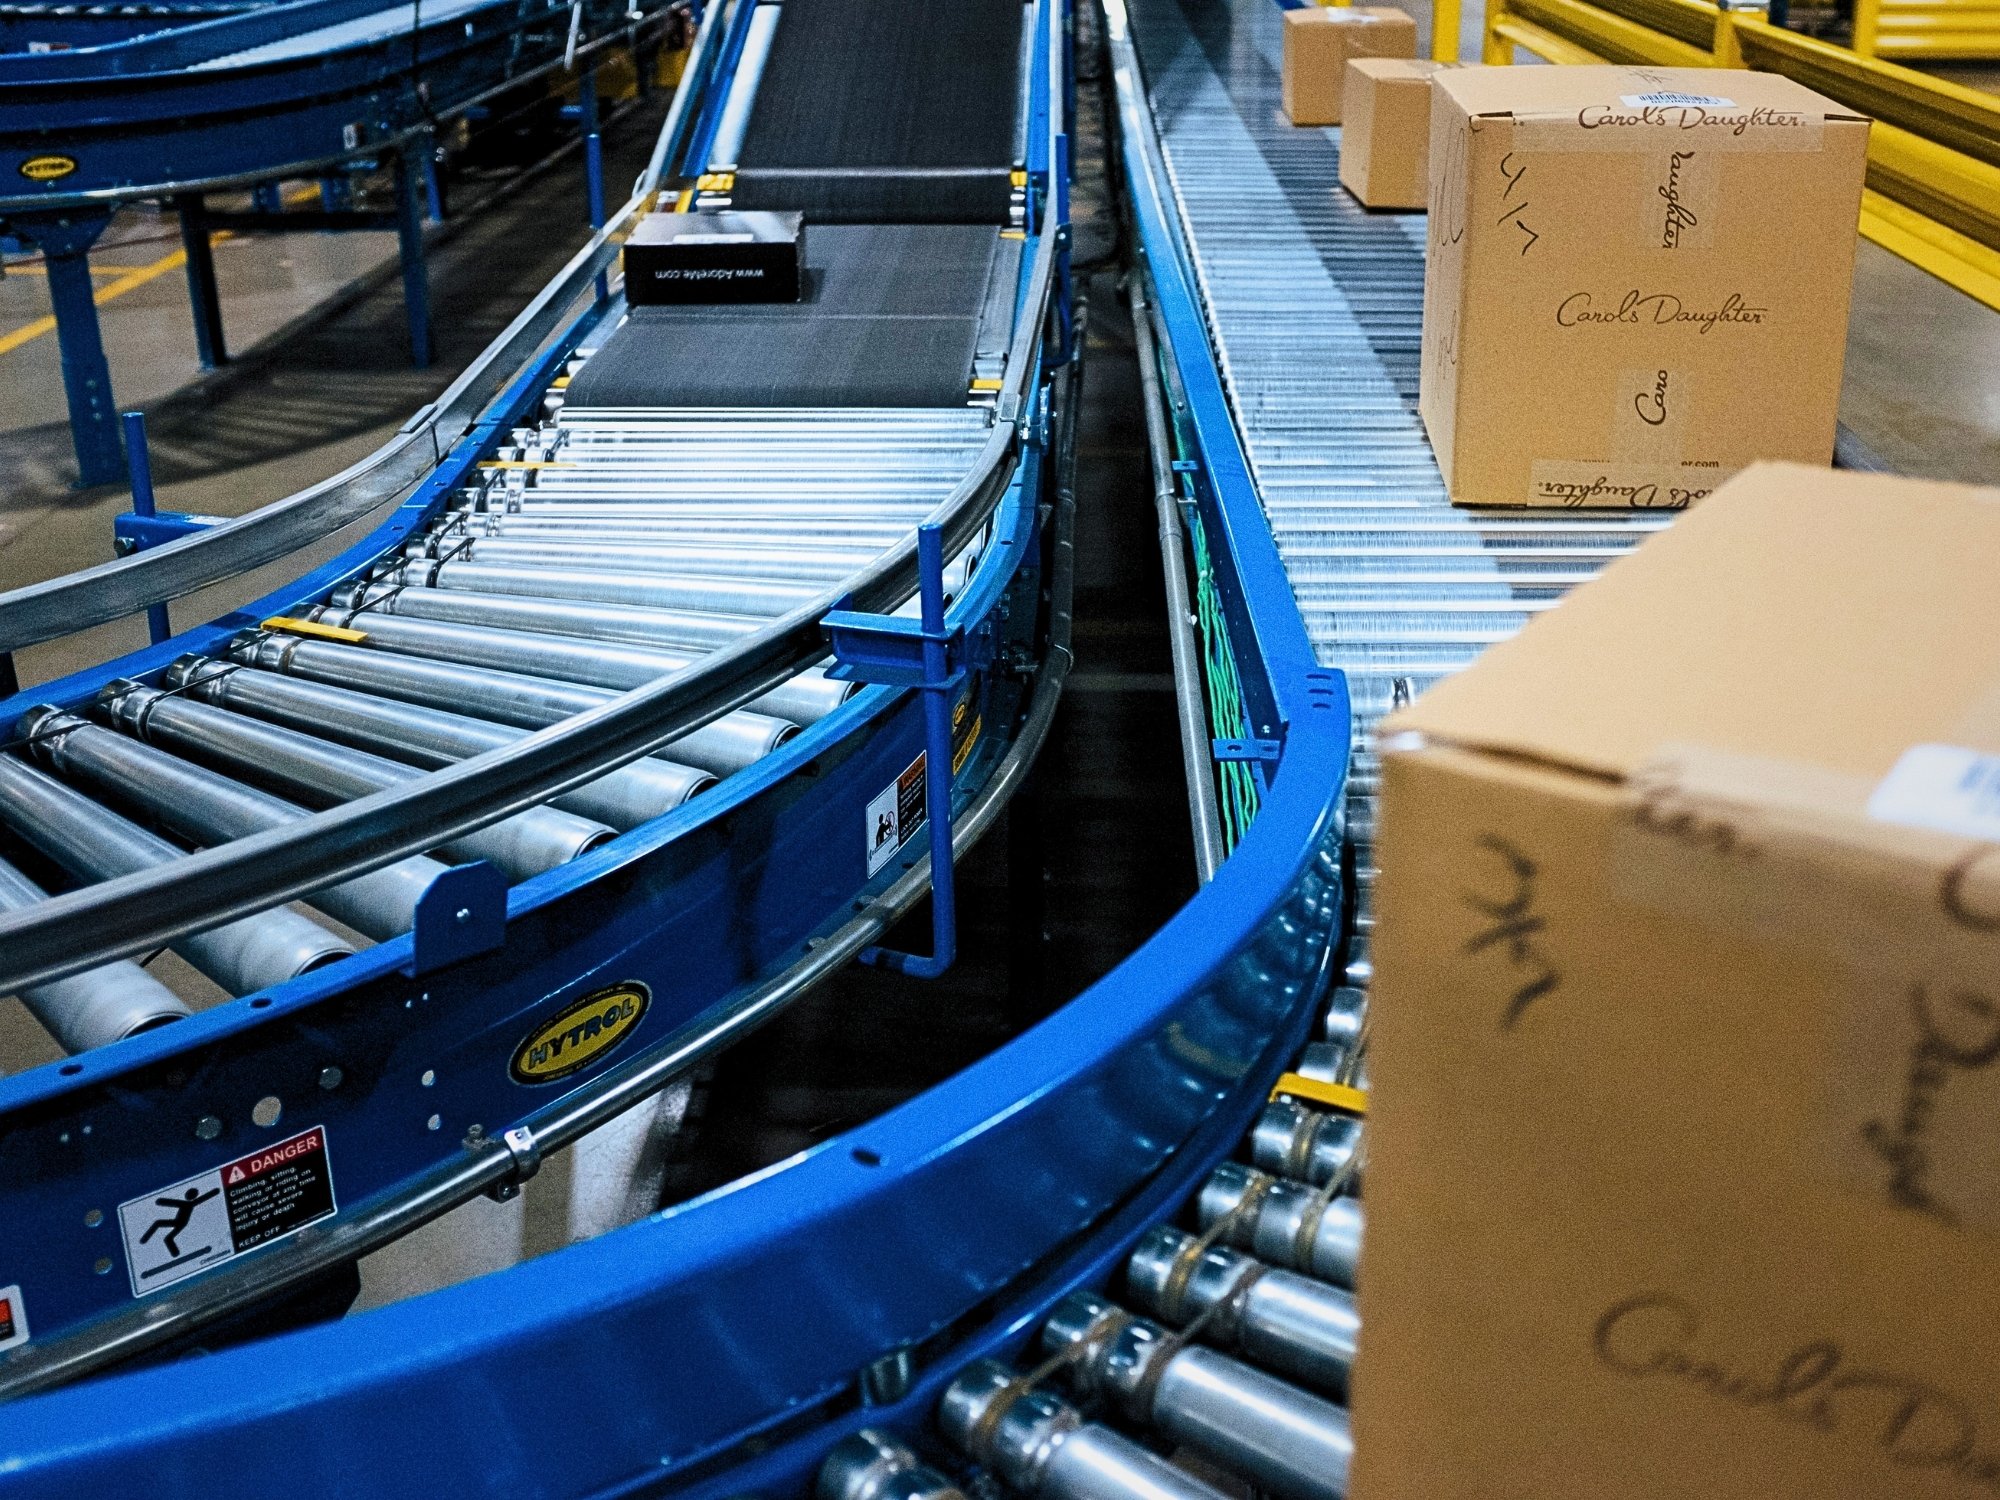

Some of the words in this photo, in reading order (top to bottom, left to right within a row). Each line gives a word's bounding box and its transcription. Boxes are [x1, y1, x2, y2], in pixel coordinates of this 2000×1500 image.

[1658, 151, 1697, 249] aughter
[528, 998, 635, 1071] HYTROL
[250, 1136, 319, 1173] DANGER
[231, 1189, 262, 1206] walking
[265, 1184, 273, 1192] or
[276, 1174, 299, 1188] riding
[301, 1169, 311, 1177] on
[233, 1196, 270, 1216] conveyor
[283, 1185, 297, 1194] any
[235, 1213, 249, 1223] will
[251, 1203, 275, 1216] cause
[262, 1213, 270, 1221] or
[273, 1202, 296, 1216] death
[238, 1233, 261, 1248] KEEP
[264, 1225, 281, 1237] OFF
